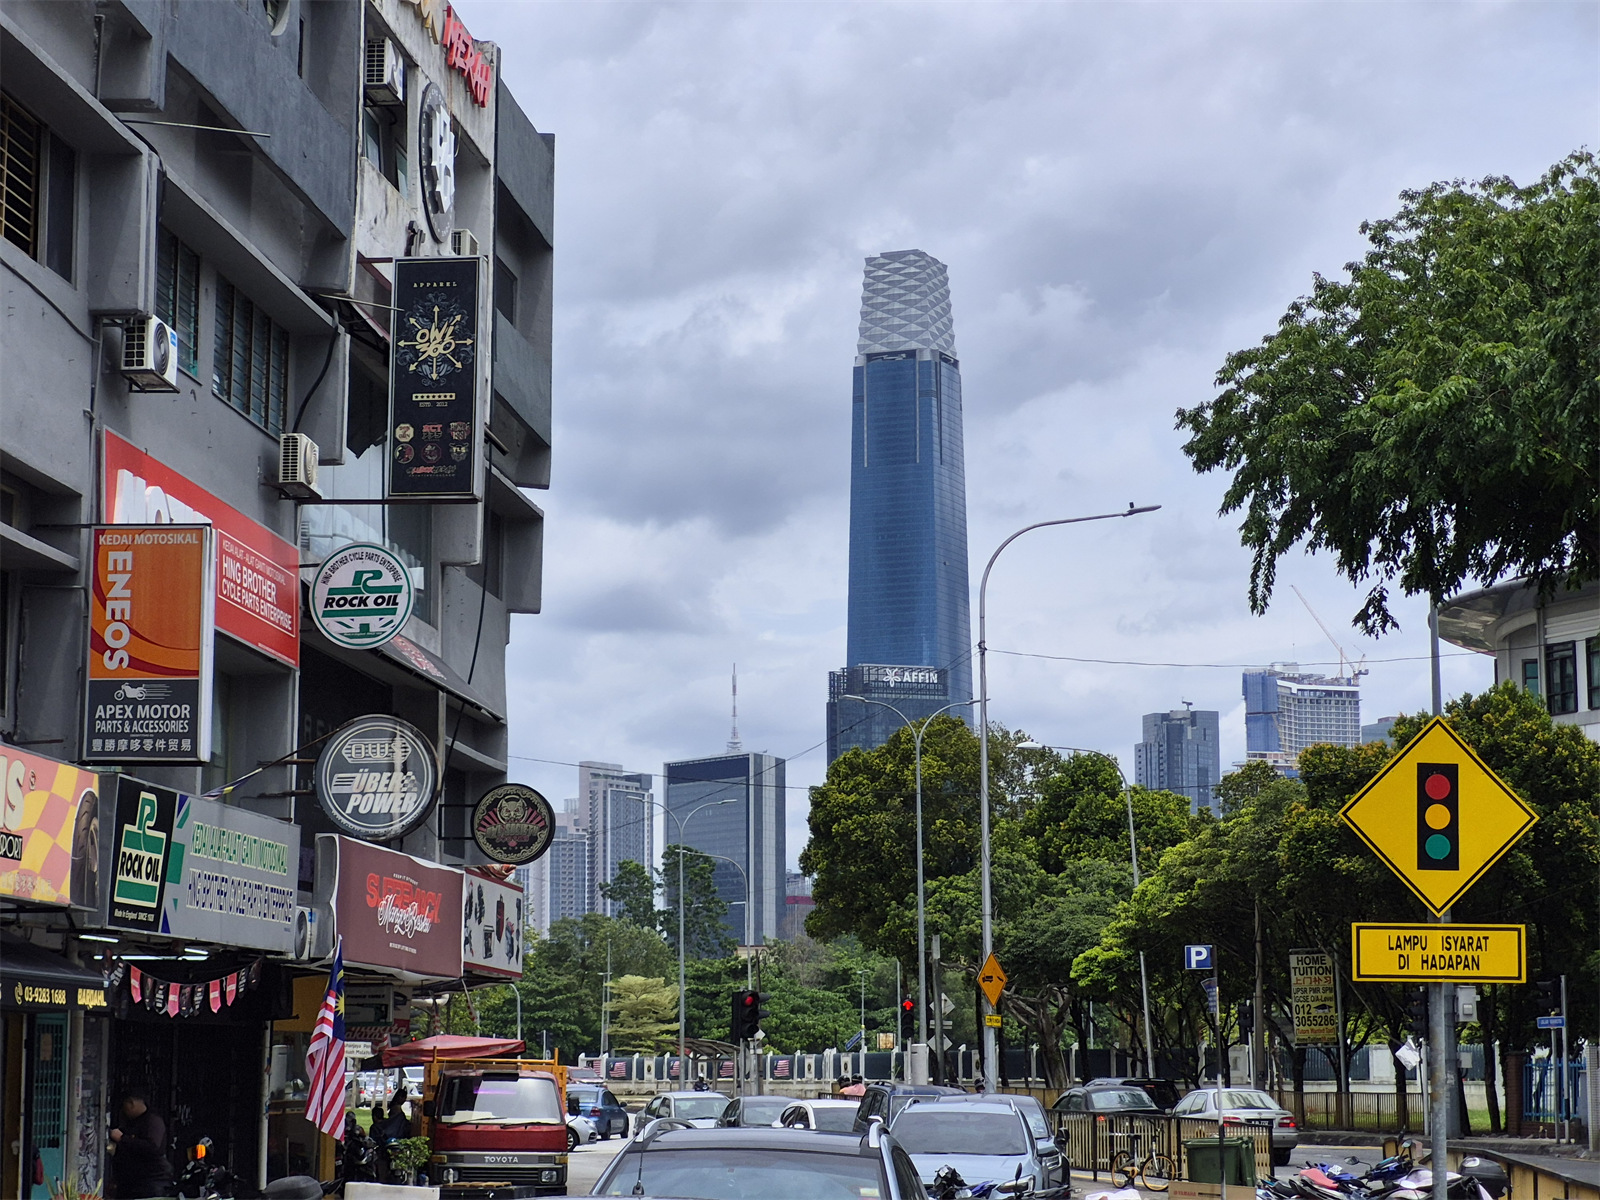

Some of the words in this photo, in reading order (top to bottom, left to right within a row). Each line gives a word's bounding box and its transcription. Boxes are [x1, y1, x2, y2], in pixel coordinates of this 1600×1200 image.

[416, 321, 455, 343] OWL
[415, 339, 456, 362] 360
[99, 534, 132, 545] KEDAI
[134, 533, 199, 545] MOTOSIKAL
[321, 571, 333, 586] HING
[328, 555, 350, 575] BROTHER
[349, 551, 364, 562] CYCLE
[364, 551, 381, 563] PARTS
[379, 556, 403, 583] ENTERPRISE
[222, 554, 242, 584] HING
[242, 565, 277, 605] BROTHER
[222, 578, 242, 603] CYCLE
[241, 588, 260, 613] PARTS
[260, 599, 292, 631] ENTERPRISE
[323, 595, 371, 609] ROCK
[373, 594, 399, 607] OIL
[103, 550, 133, 671] ENEOS
[902, 671, 938, 684] AFFIN
[95, 704, 134, 719] APEX
[136, 704, 190, 719] MOTOR
[95, 720, 122, 733] PARTS
[123, 720, 131, 733] &
[132, 720, 189, 733] ACCESSORIES
[351, 768, 406, 793] ÜBER
[345, 792, 418, 814] POWER
[119, 851, 145, 880] ROCK
[145, 856, 160, 882] OIL
[1388, 935, 1428, 951] LAMPU
[1441, 935, 1490, 952] ISYARAT
[1190, 947, 1208, 968] P
[1296, 955, 1327, 966] HOME
[1398, 954, 1410, 970] DI
[1421, 954, 1480, 971] HADAPAN
[1292, 966, 1332, 976] TUITION
[24, 986, 50, 1004] 03-9283
[51, 988, 66, 1005] 1688
[78, 988, 108, 1009] BARDAHL
[1292, 987, 1308, 995] UPSR
[1308, 986, 1320, 994] PMR
[1322, 986, 1334, 994] SPM
[1294, 1004, 1312, 1015] 012
[1295, 1015, 1335, 1027] 3055286
